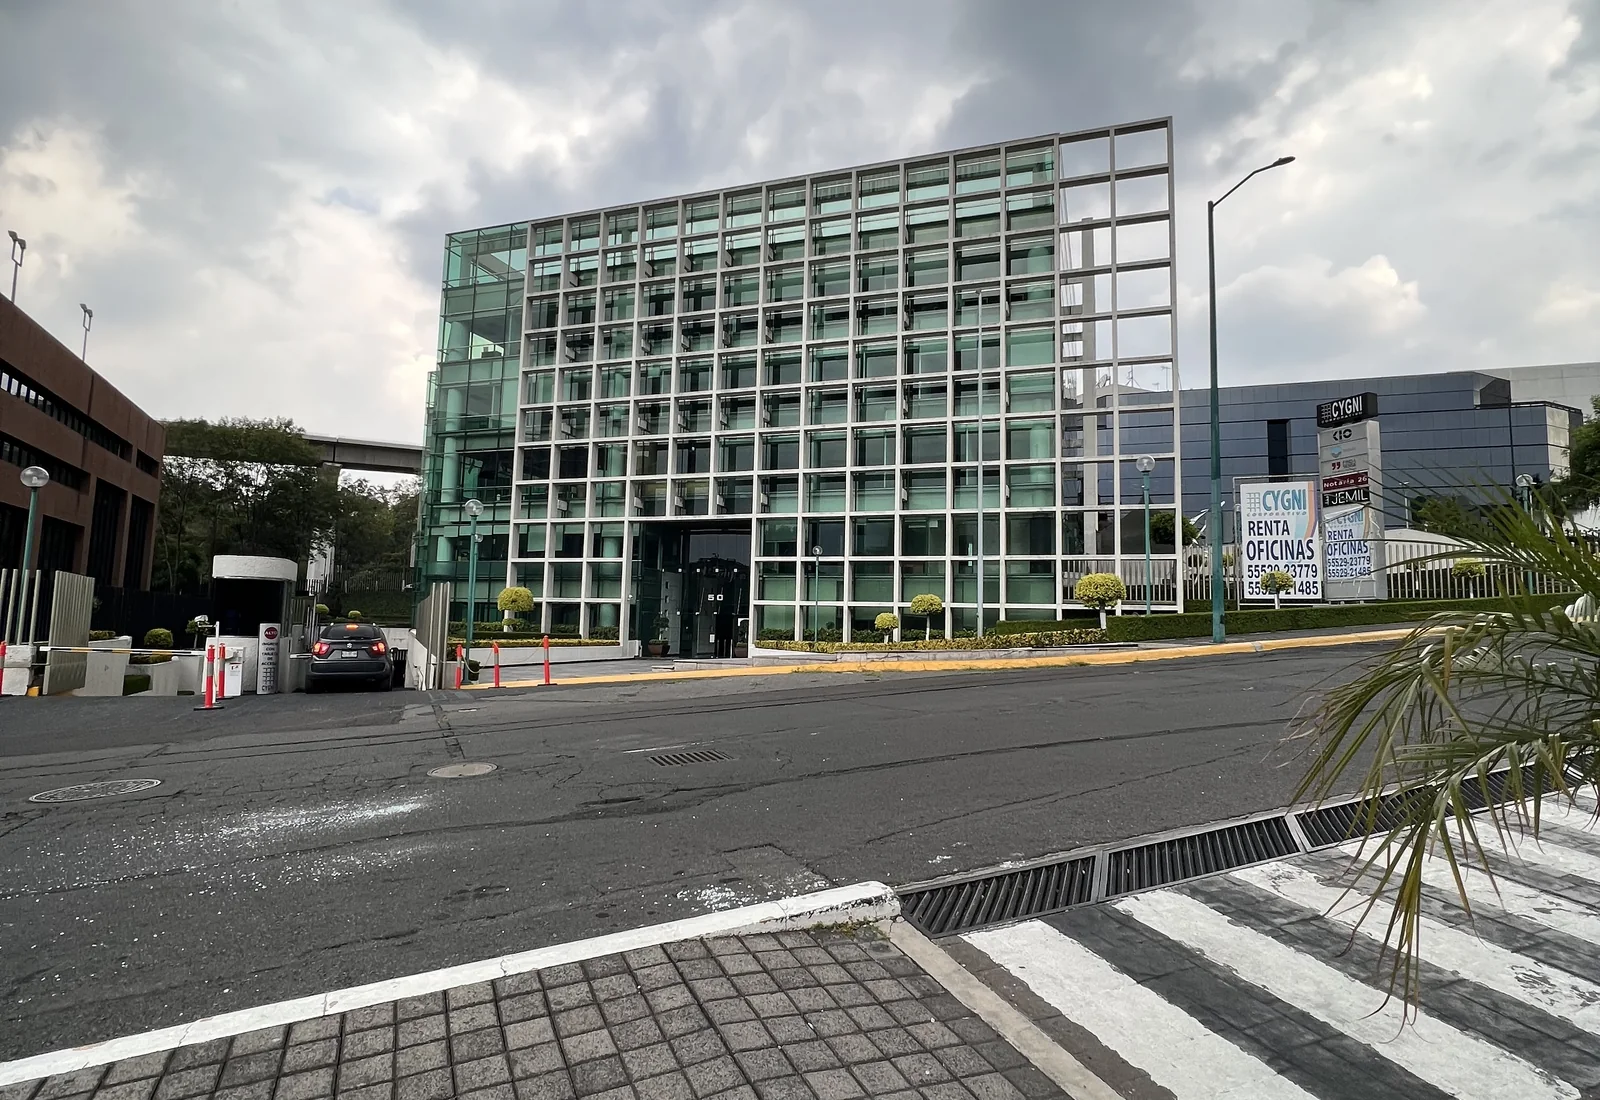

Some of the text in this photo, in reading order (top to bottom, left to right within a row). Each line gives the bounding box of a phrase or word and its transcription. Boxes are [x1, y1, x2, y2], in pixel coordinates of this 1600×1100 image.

[1332, 396, 1362, 417] CYGNI
[1262, 489, 1307, 511] CYGNI
[1331, 489, 1368, 504] JEMIL
[1248, 520, 1290, 536] RENTA
[1327, 529, 1353, 540] RENTA
[1246, 539, 1314, 560] OFICINAS
[1327, 541, 1368, 556] OFICINAS
[1327, 556, 1370, 567] 55529-23779
[1247, 564, 1318, 578] 555223779
[1328, 567, 1371, 578] 55529-21485
